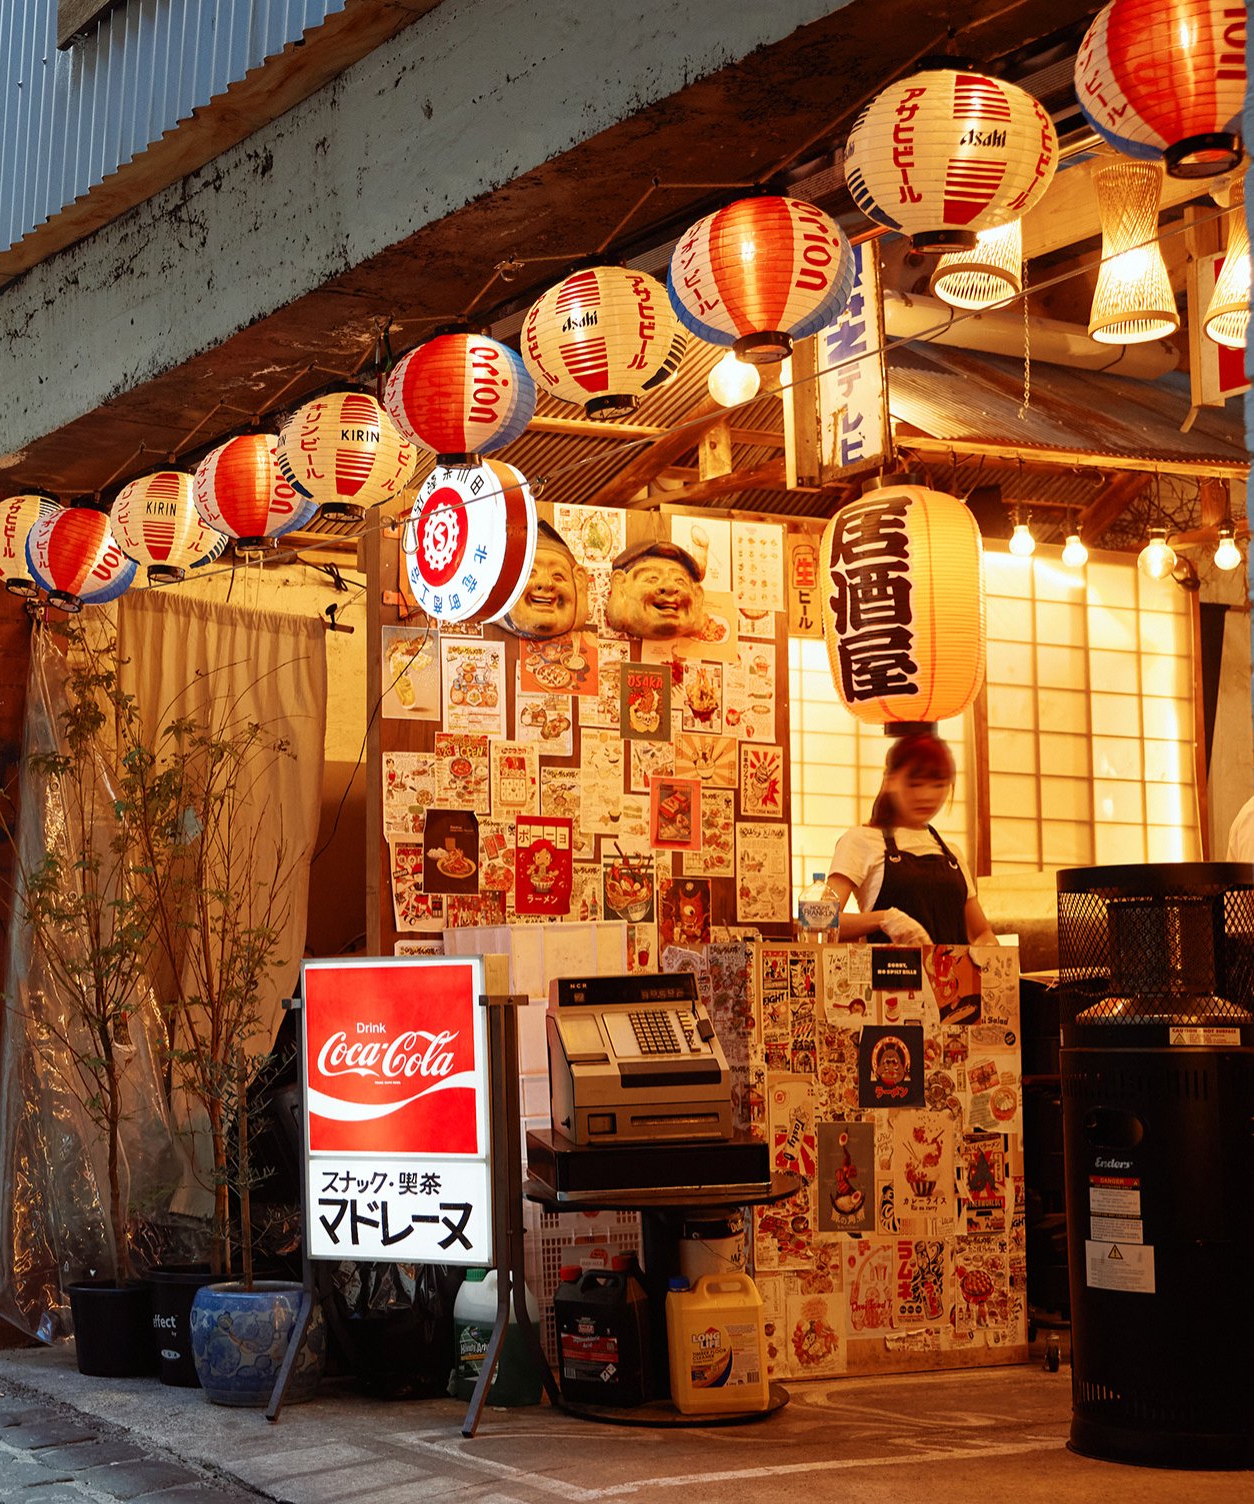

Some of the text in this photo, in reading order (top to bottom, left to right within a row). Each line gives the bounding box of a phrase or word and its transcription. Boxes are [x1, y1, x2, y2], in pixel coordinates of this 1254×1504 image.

[893, 88, 928, 204] アサヒビール
[960, 128, 1007, 148] Asahi
[791, 201, 840, 291] orion
[562, 310, 598, 333] Asahi
[625, 275, 656, 370] アサヒビール
[527, 293, 560, 386] アサヒビール
[468, 347, 509, 424] orion
[300, 403, 329, 480] キリンビール
[341, 429, 380, 443] KIRIN
[381, 436, 411, 492] ンビール
[116, 481, 139, 548] キリンビール
[146, 501, 177, 517] KIRIN
[2, 498, 27, 559] アサヒビール
[795, 557, 816, 631] 生ビール
[829, 496, 918, 703] 居酒屋
[627, 674, 664, 689] OSAKA
[460, 746, 484, 758] OPEN
[526, 895, 558, 905] ラーメン
[887, 962, 908, 970] SORRY,
[356, 1022, 387, 1034] Drink
[988, 1014, 1009, 1025] Salad
[317, 1030, 460, 1077] Coca-Cola
[787, 1118, 806, 1149] Tasty
[1095, 1157, 1130, 1169] Enders
[321, 1171, 442, 1195] スナック・喫茶
[903, 1196, 947, 1206] カレーライス
[318, 1198, 473, 1250] マドレーヌ
[897, 1240, 913, 1300] ラムネ
[692, 1332, 720, 1344] LONG
[700, 1339, 720, 1350] LIFE
